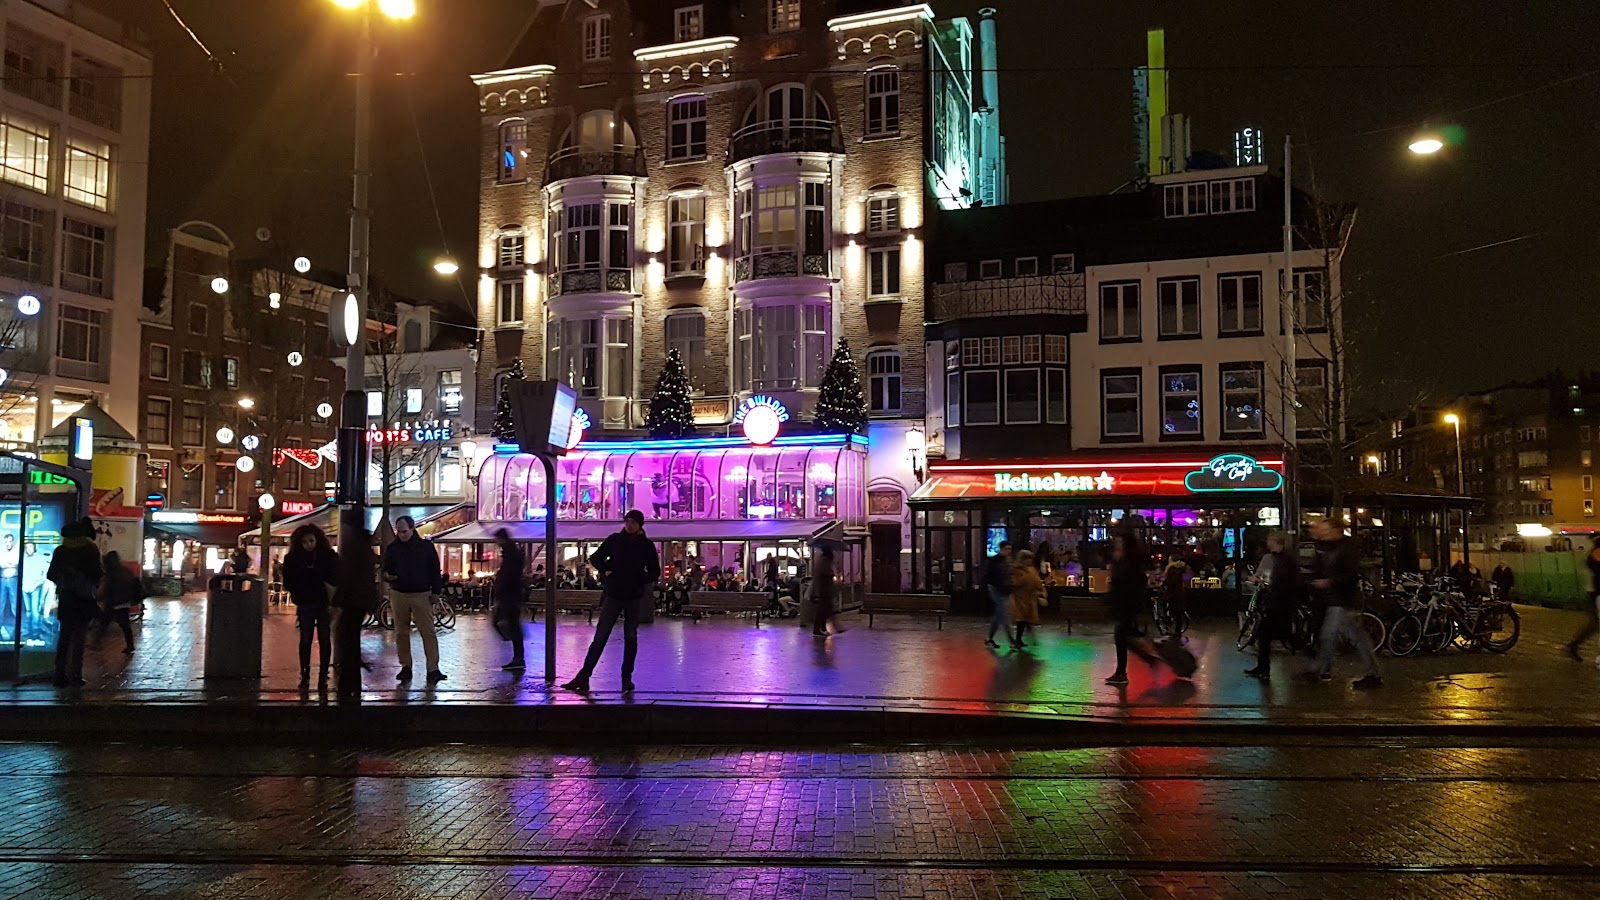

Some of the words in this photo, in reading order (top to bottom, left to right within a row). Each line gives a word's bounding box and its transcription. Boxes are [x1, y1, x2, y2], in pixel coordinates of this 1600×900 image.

[1244, 128, 1253, 163] CITY
[733, 403, 749, 424] THE
[747, 395, 789, 422] BULLDOG
[994, 472, 1094, 491] Heineken
[282, 501, 314, 513] RANCHO
[197, 513, 245, 523] Steakhouse
